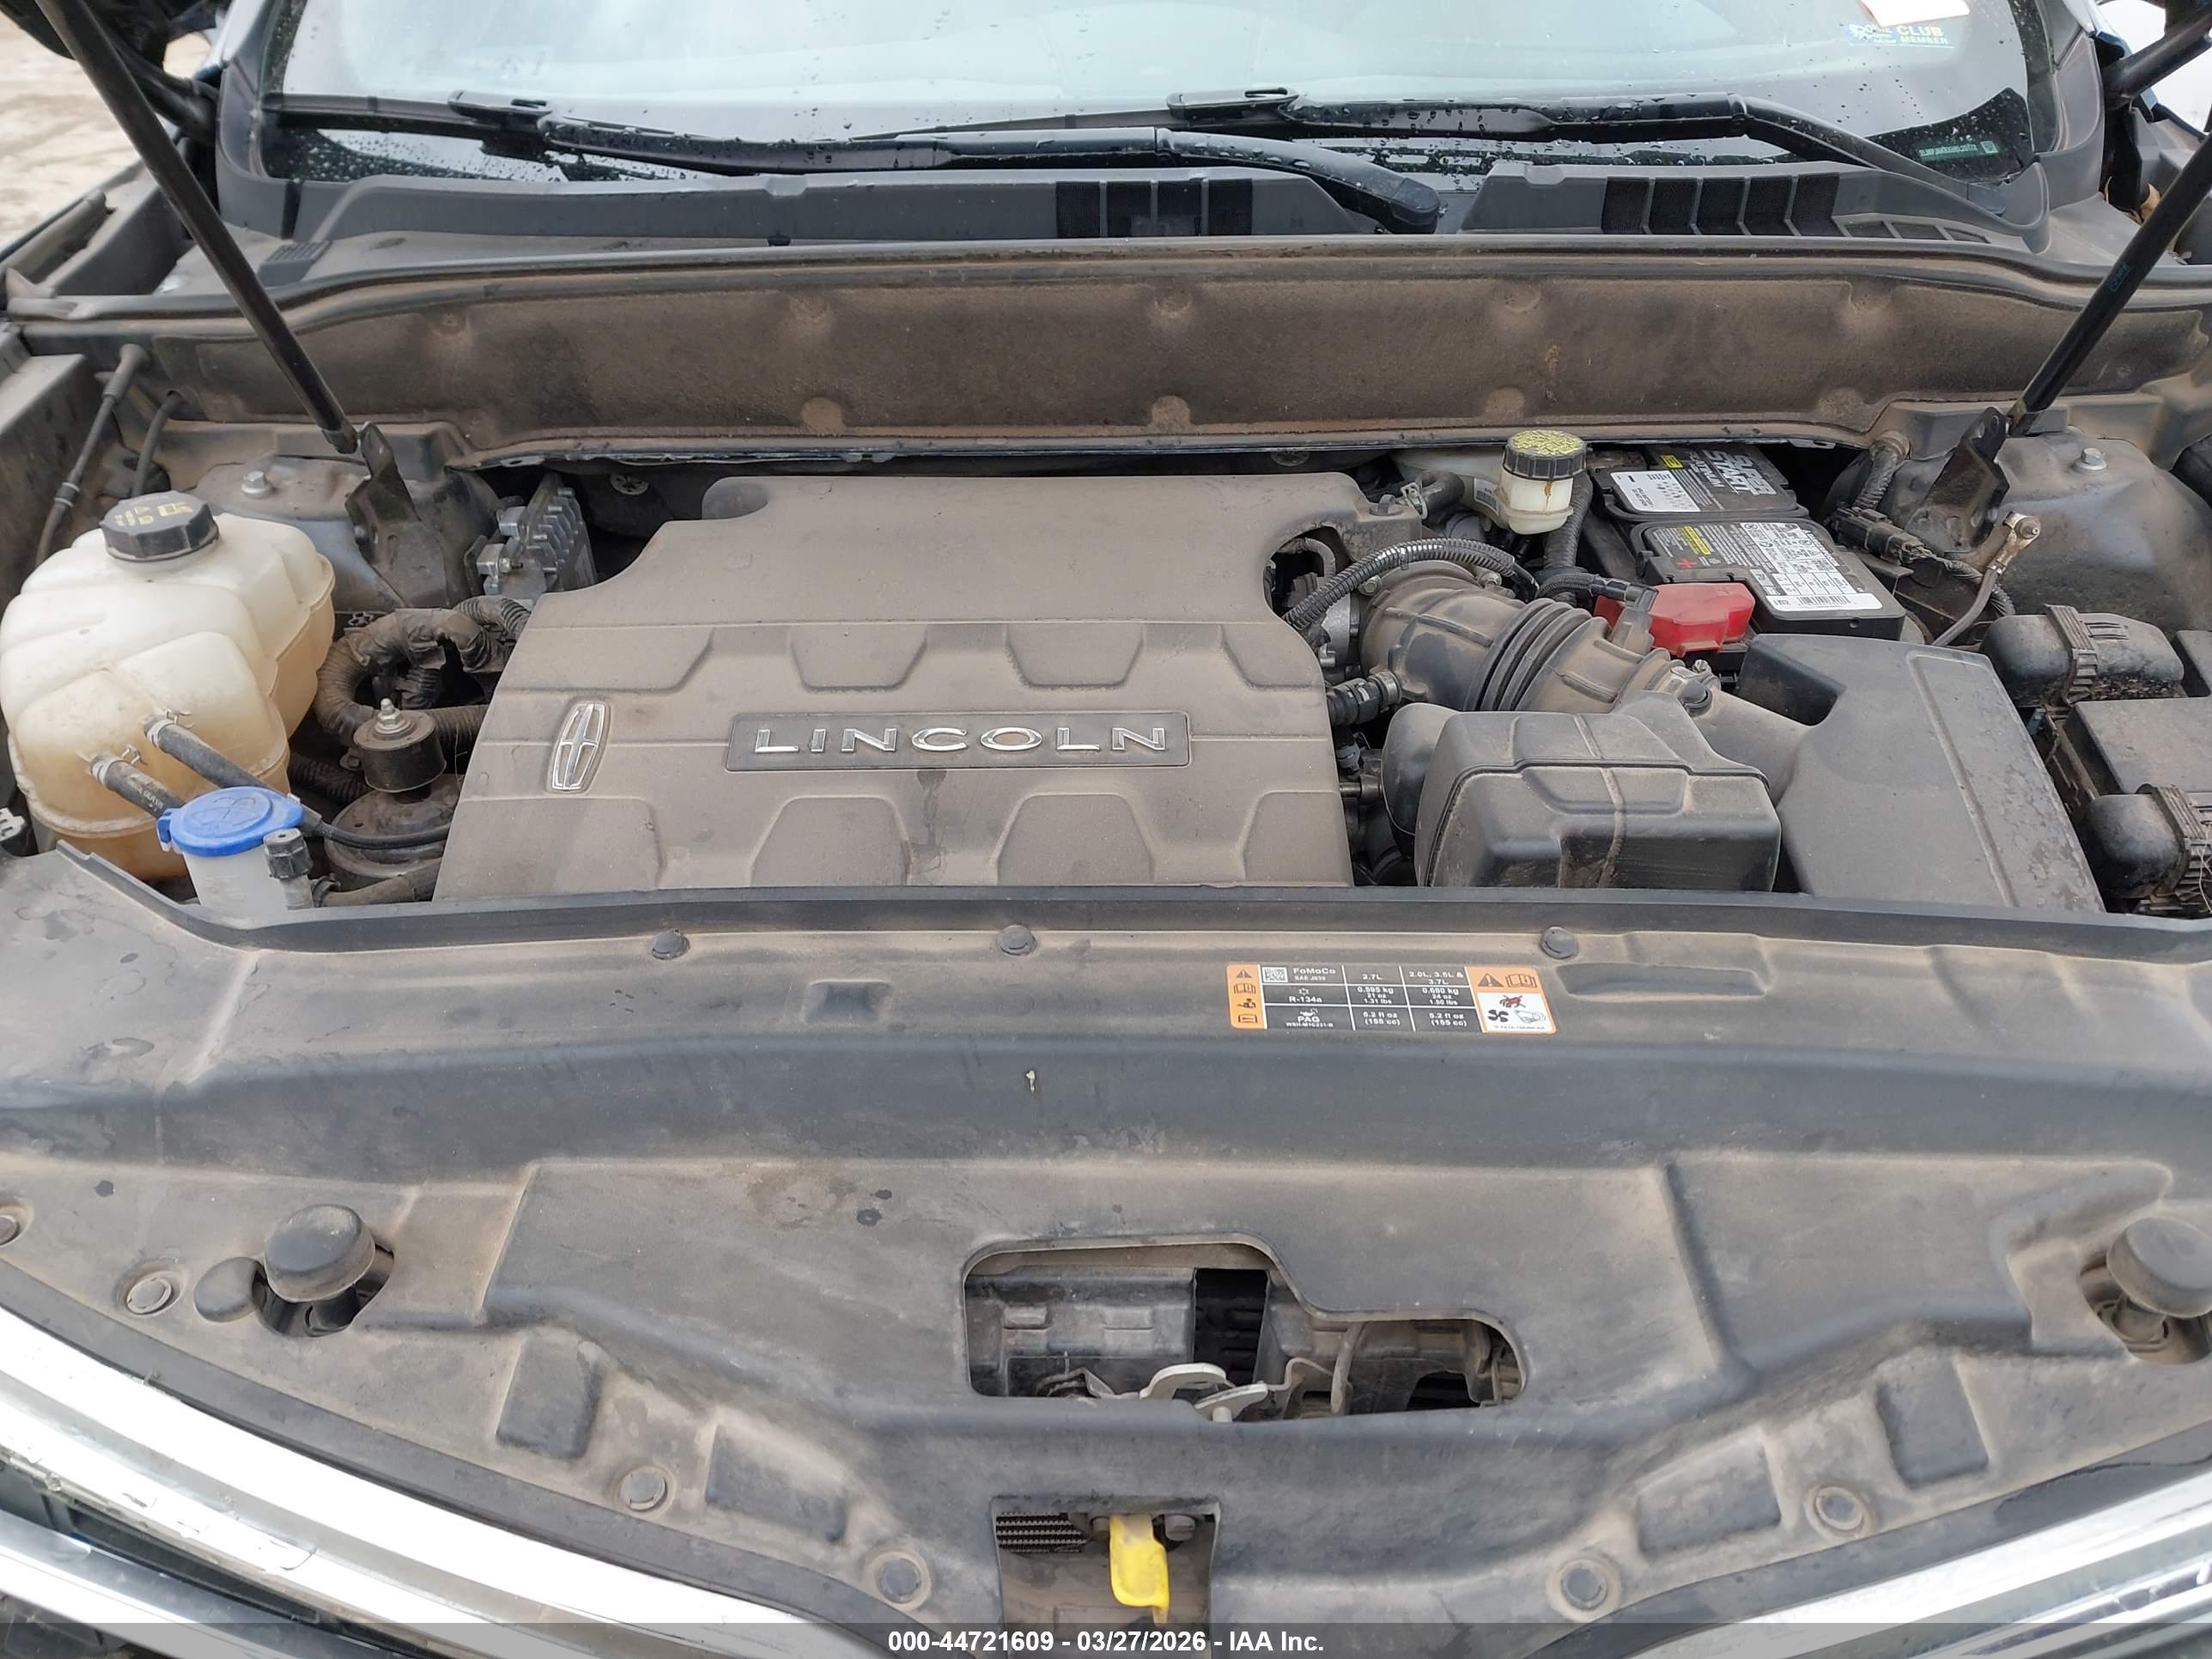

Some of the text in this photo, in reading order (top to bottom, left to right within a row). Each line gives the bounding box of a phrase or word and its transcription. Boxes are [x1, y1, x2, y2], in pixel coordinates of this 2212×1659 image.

[1896, 25, 1943, 36] CLUB
[1702, 449, 1759, 495] START
[755, 727, 1166, 753] LINCOLN
